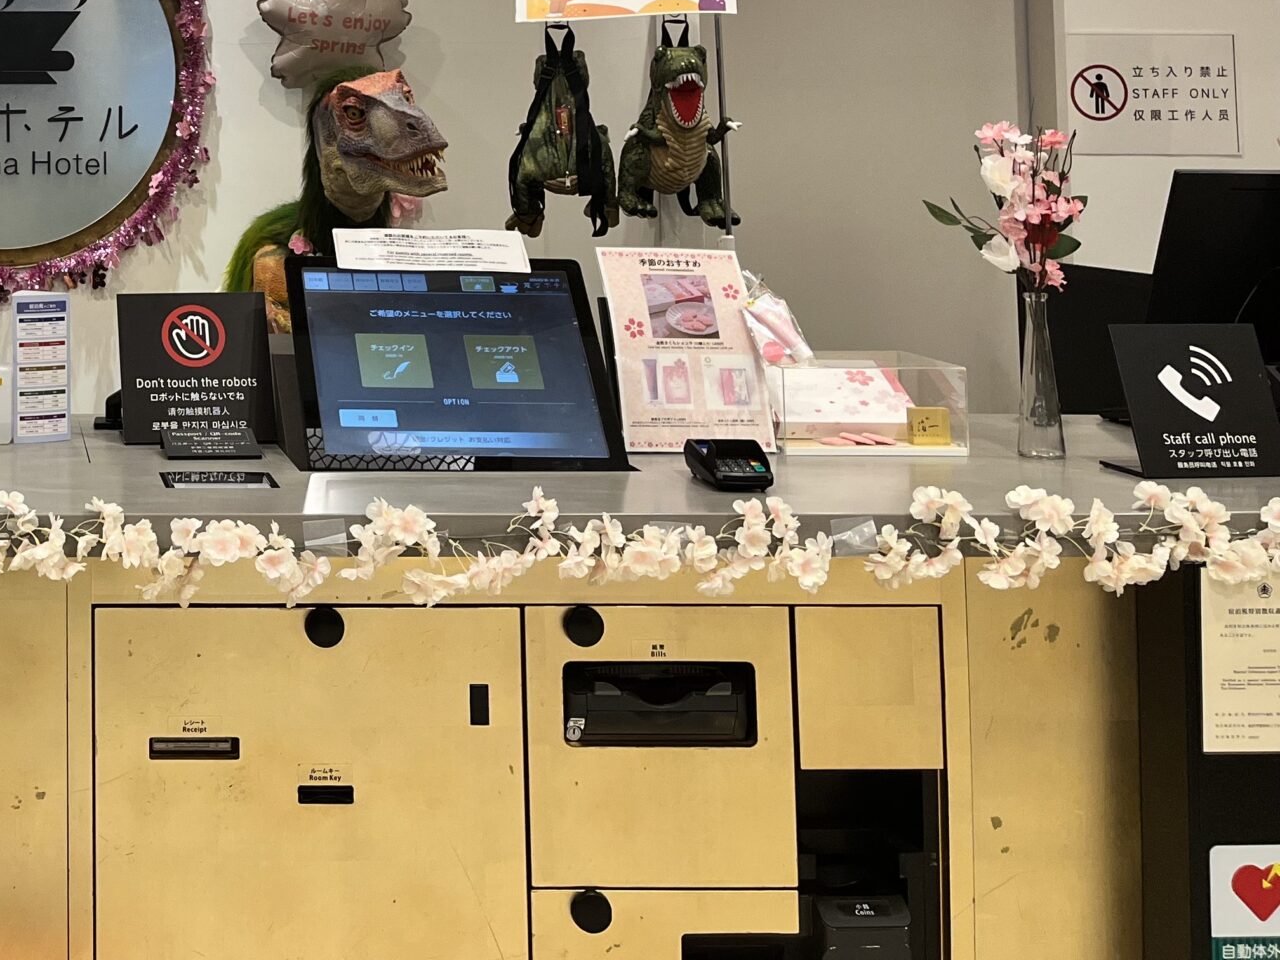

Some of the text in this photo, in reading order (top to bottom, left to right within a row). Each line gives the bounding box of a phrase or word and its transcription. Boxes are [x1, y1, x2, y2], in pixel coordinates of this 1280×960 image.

[287, 6, 391, 32] Lets enjoy
[1132, 66, 1228, 78] 立ち入り禁止
[1132, 88, 1229, 99] STAFF ONLY
[1133, 109, 1230, 121] 仅限工作人员
[31, 151, 108, 176] Hotel
[639, 258, 701, 267] 季節のおすすめ
[369, 309, 512, 319] ご希望のメニューを選択してください
[369, 343, 415, 352] チェックイン
[475, 345, 528, 354] チェックアウト
[136, 376, 257, 389] Don't touch the robots
[150, 391, 245, 402] ロボットに触らないでね
[443, 398, 470, 406] OPTION
[1162, 432, 1257, 446] Staff call phone
[1168, 447, 1258, 458] スタッフ呼び出し電話
[182, 726, 207, 734] Receipt
[329, 774, 342, 783] Key
[1222, 943, 1280, 959] 自動体外
